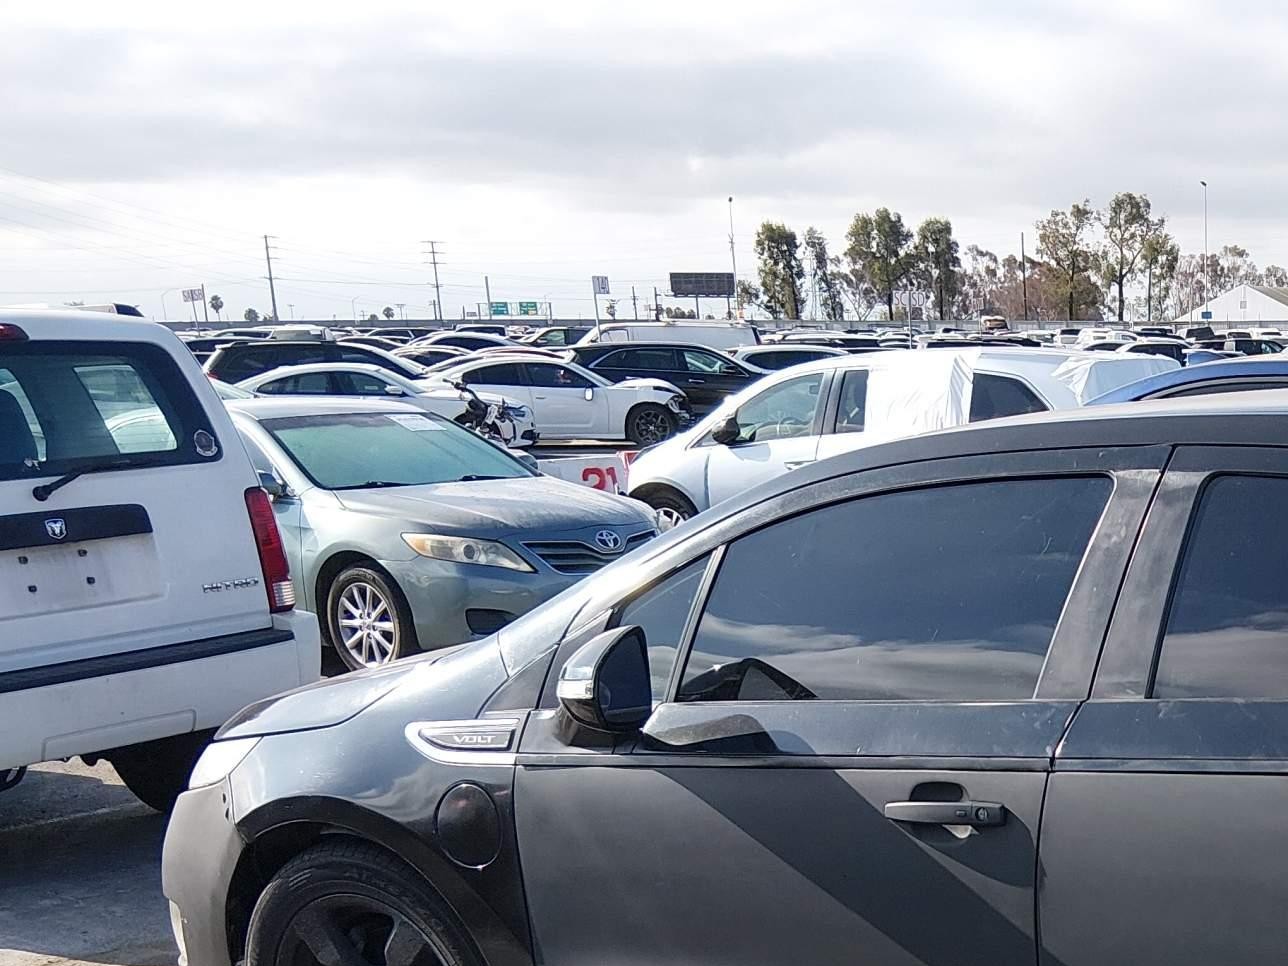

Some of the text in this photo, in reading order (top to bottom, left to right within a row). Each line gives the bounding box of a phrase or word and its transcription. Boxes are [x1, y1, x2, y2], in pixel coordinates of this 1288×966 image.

[893, 291, 925, 307] SC SD
[453, 735, 497, 744] VOLT
